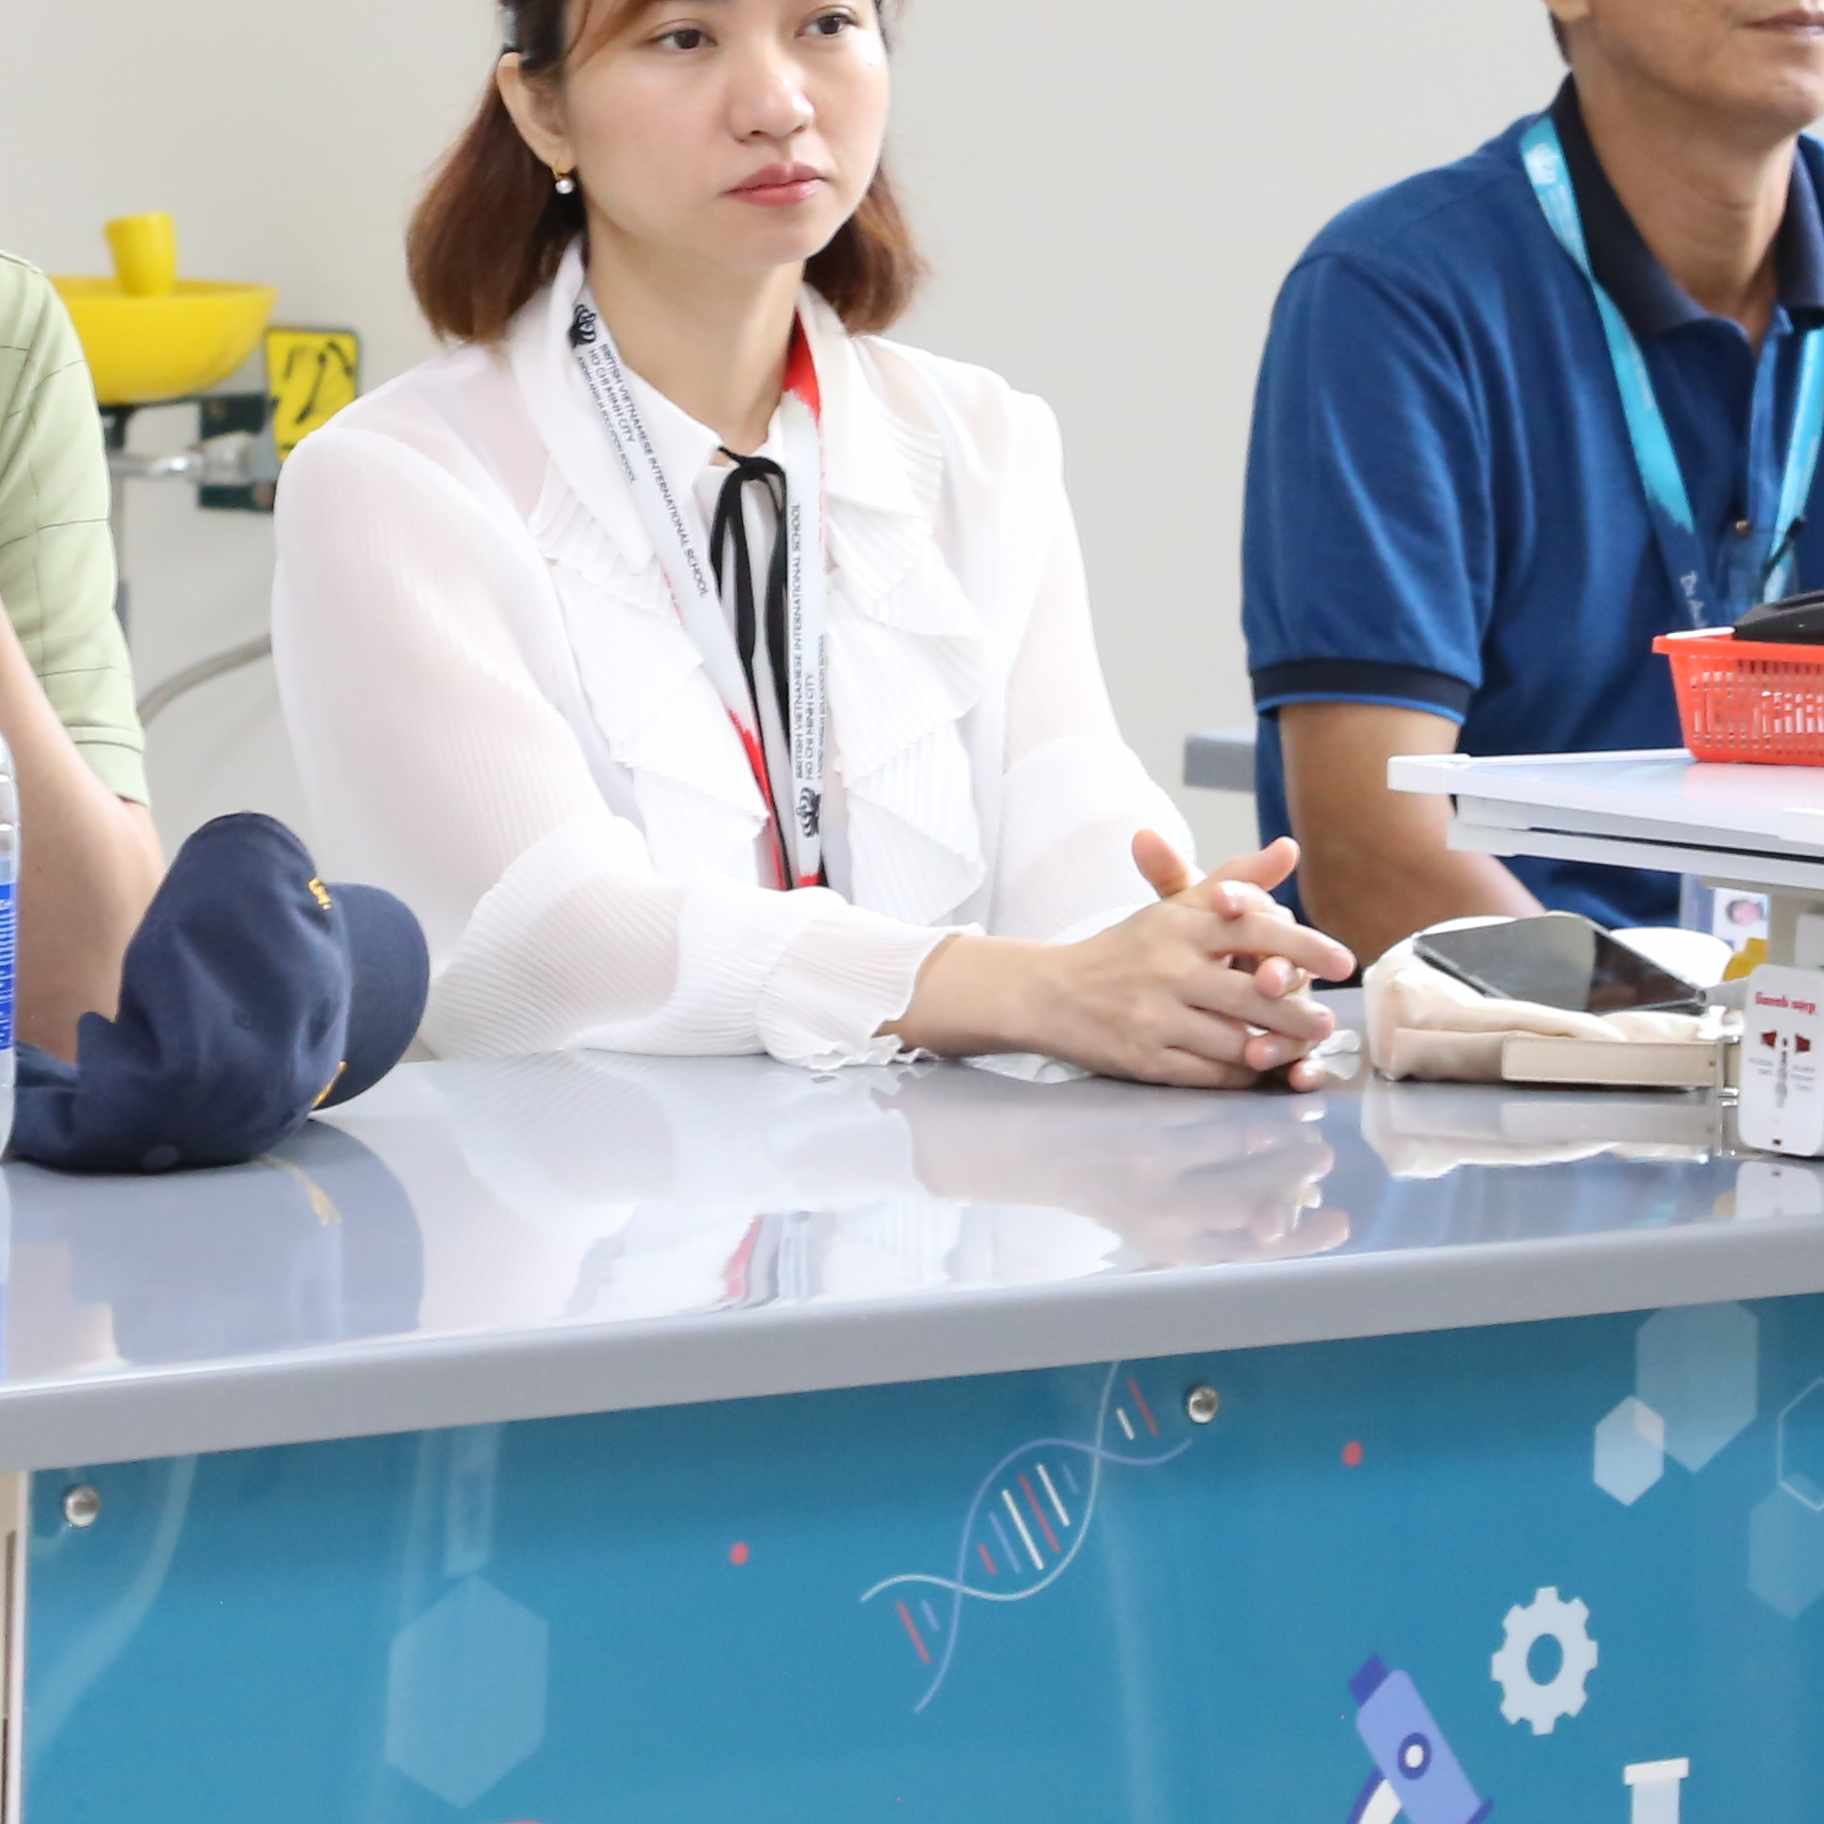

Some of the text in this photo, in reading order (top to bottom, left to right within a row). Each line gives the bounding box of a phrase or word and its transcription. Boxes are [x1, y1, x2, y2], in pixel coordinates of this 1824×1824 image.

[646, 455, 690, 546] INTERNATIONAL
[682, 546, 710, 596] SCHOOL
[791, 504, 800, 551] SCHOOL
